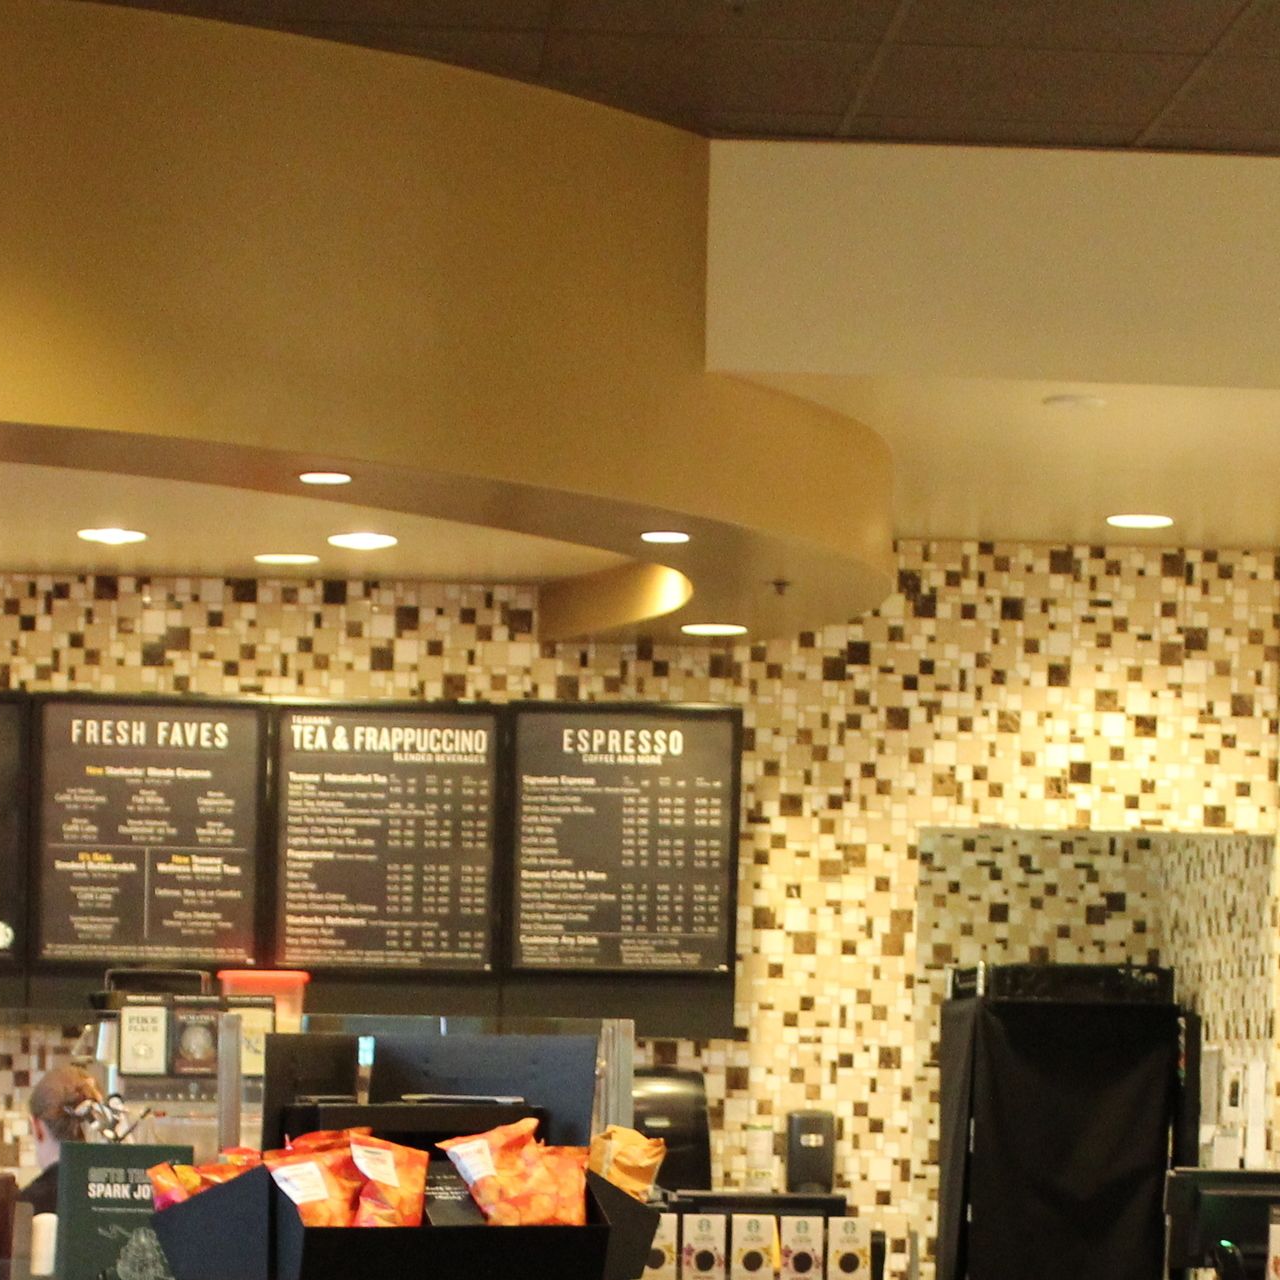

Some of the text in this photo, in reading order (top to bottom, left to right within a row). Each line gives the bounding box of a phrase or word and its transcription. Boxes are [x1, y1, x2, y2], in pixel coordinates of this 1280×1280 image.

[71, 719, 228, 748] FRESH FAVES
[291, 725, 488, 753] TEA & FRAPPUCCINO
[563, 729, 683, 756] ESPRESSO
[582, 754, 615, 764] COFFEE
[88, 1182, 152, 1200] SPARK JO
